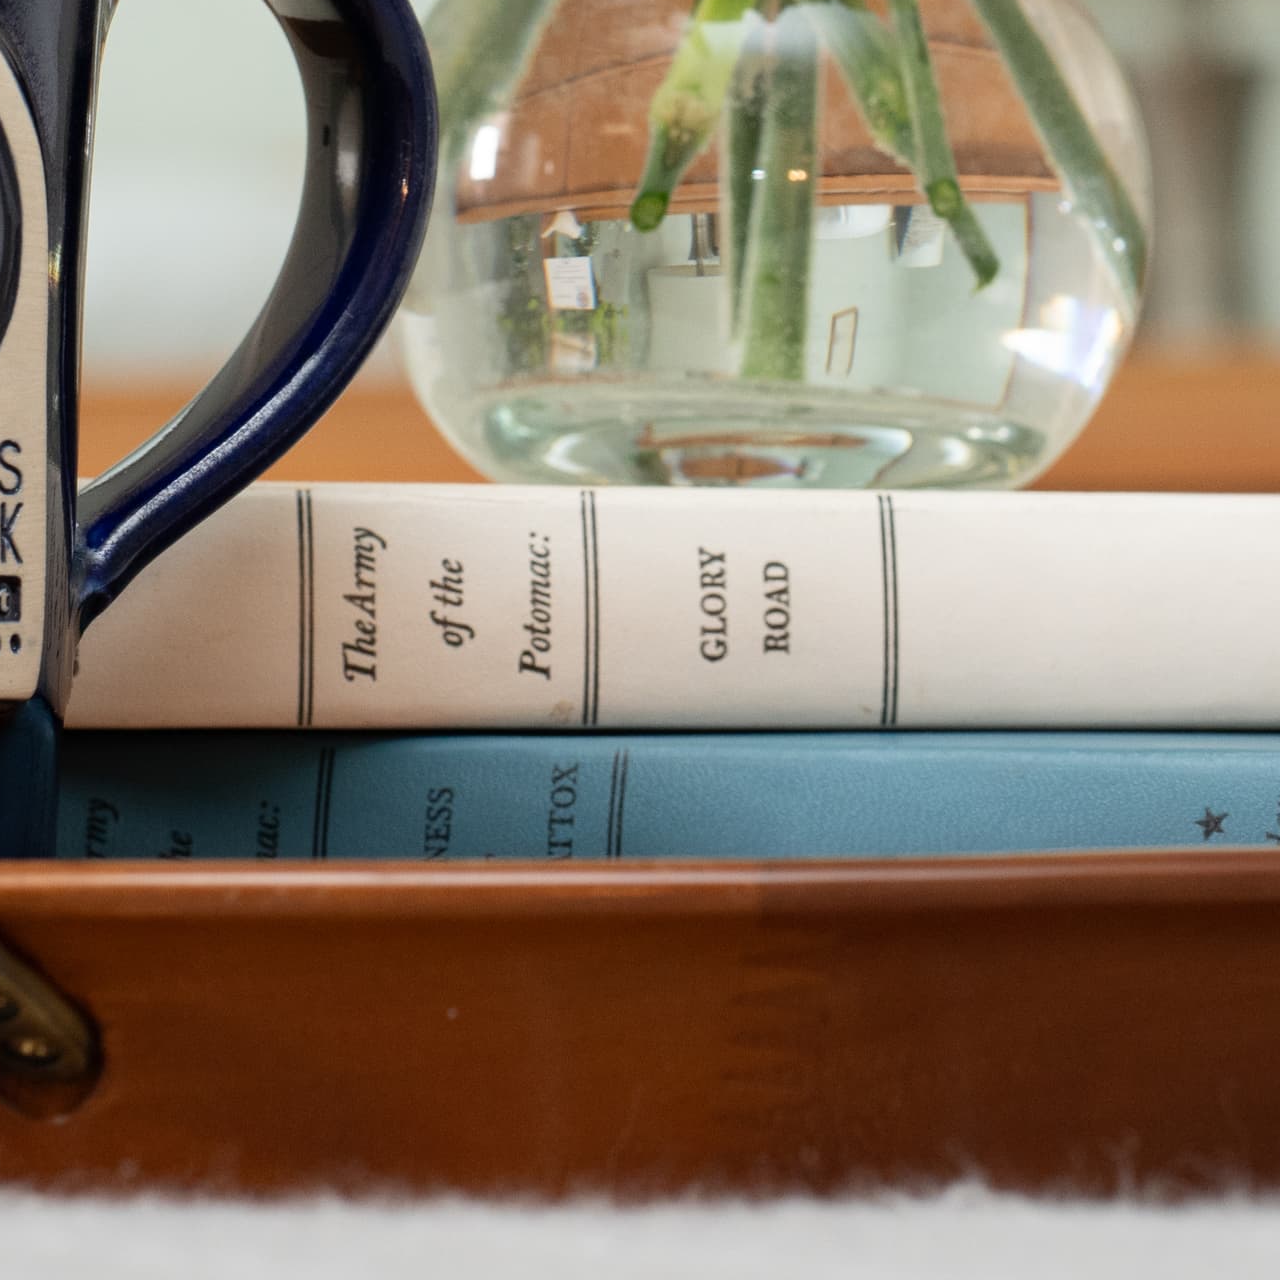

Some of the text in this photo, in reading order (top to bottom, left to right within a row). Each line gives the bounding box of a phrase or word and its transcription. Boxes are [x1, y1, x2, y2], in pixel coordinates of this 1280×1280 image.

[428, 557, 476, 649] of the
[518, 531, 552, 681] Potomac:
[698, 546, 728, 663] GLORY
[763, 560, 791, 655] ROAD
[85, 797, 119, 858] rmy
